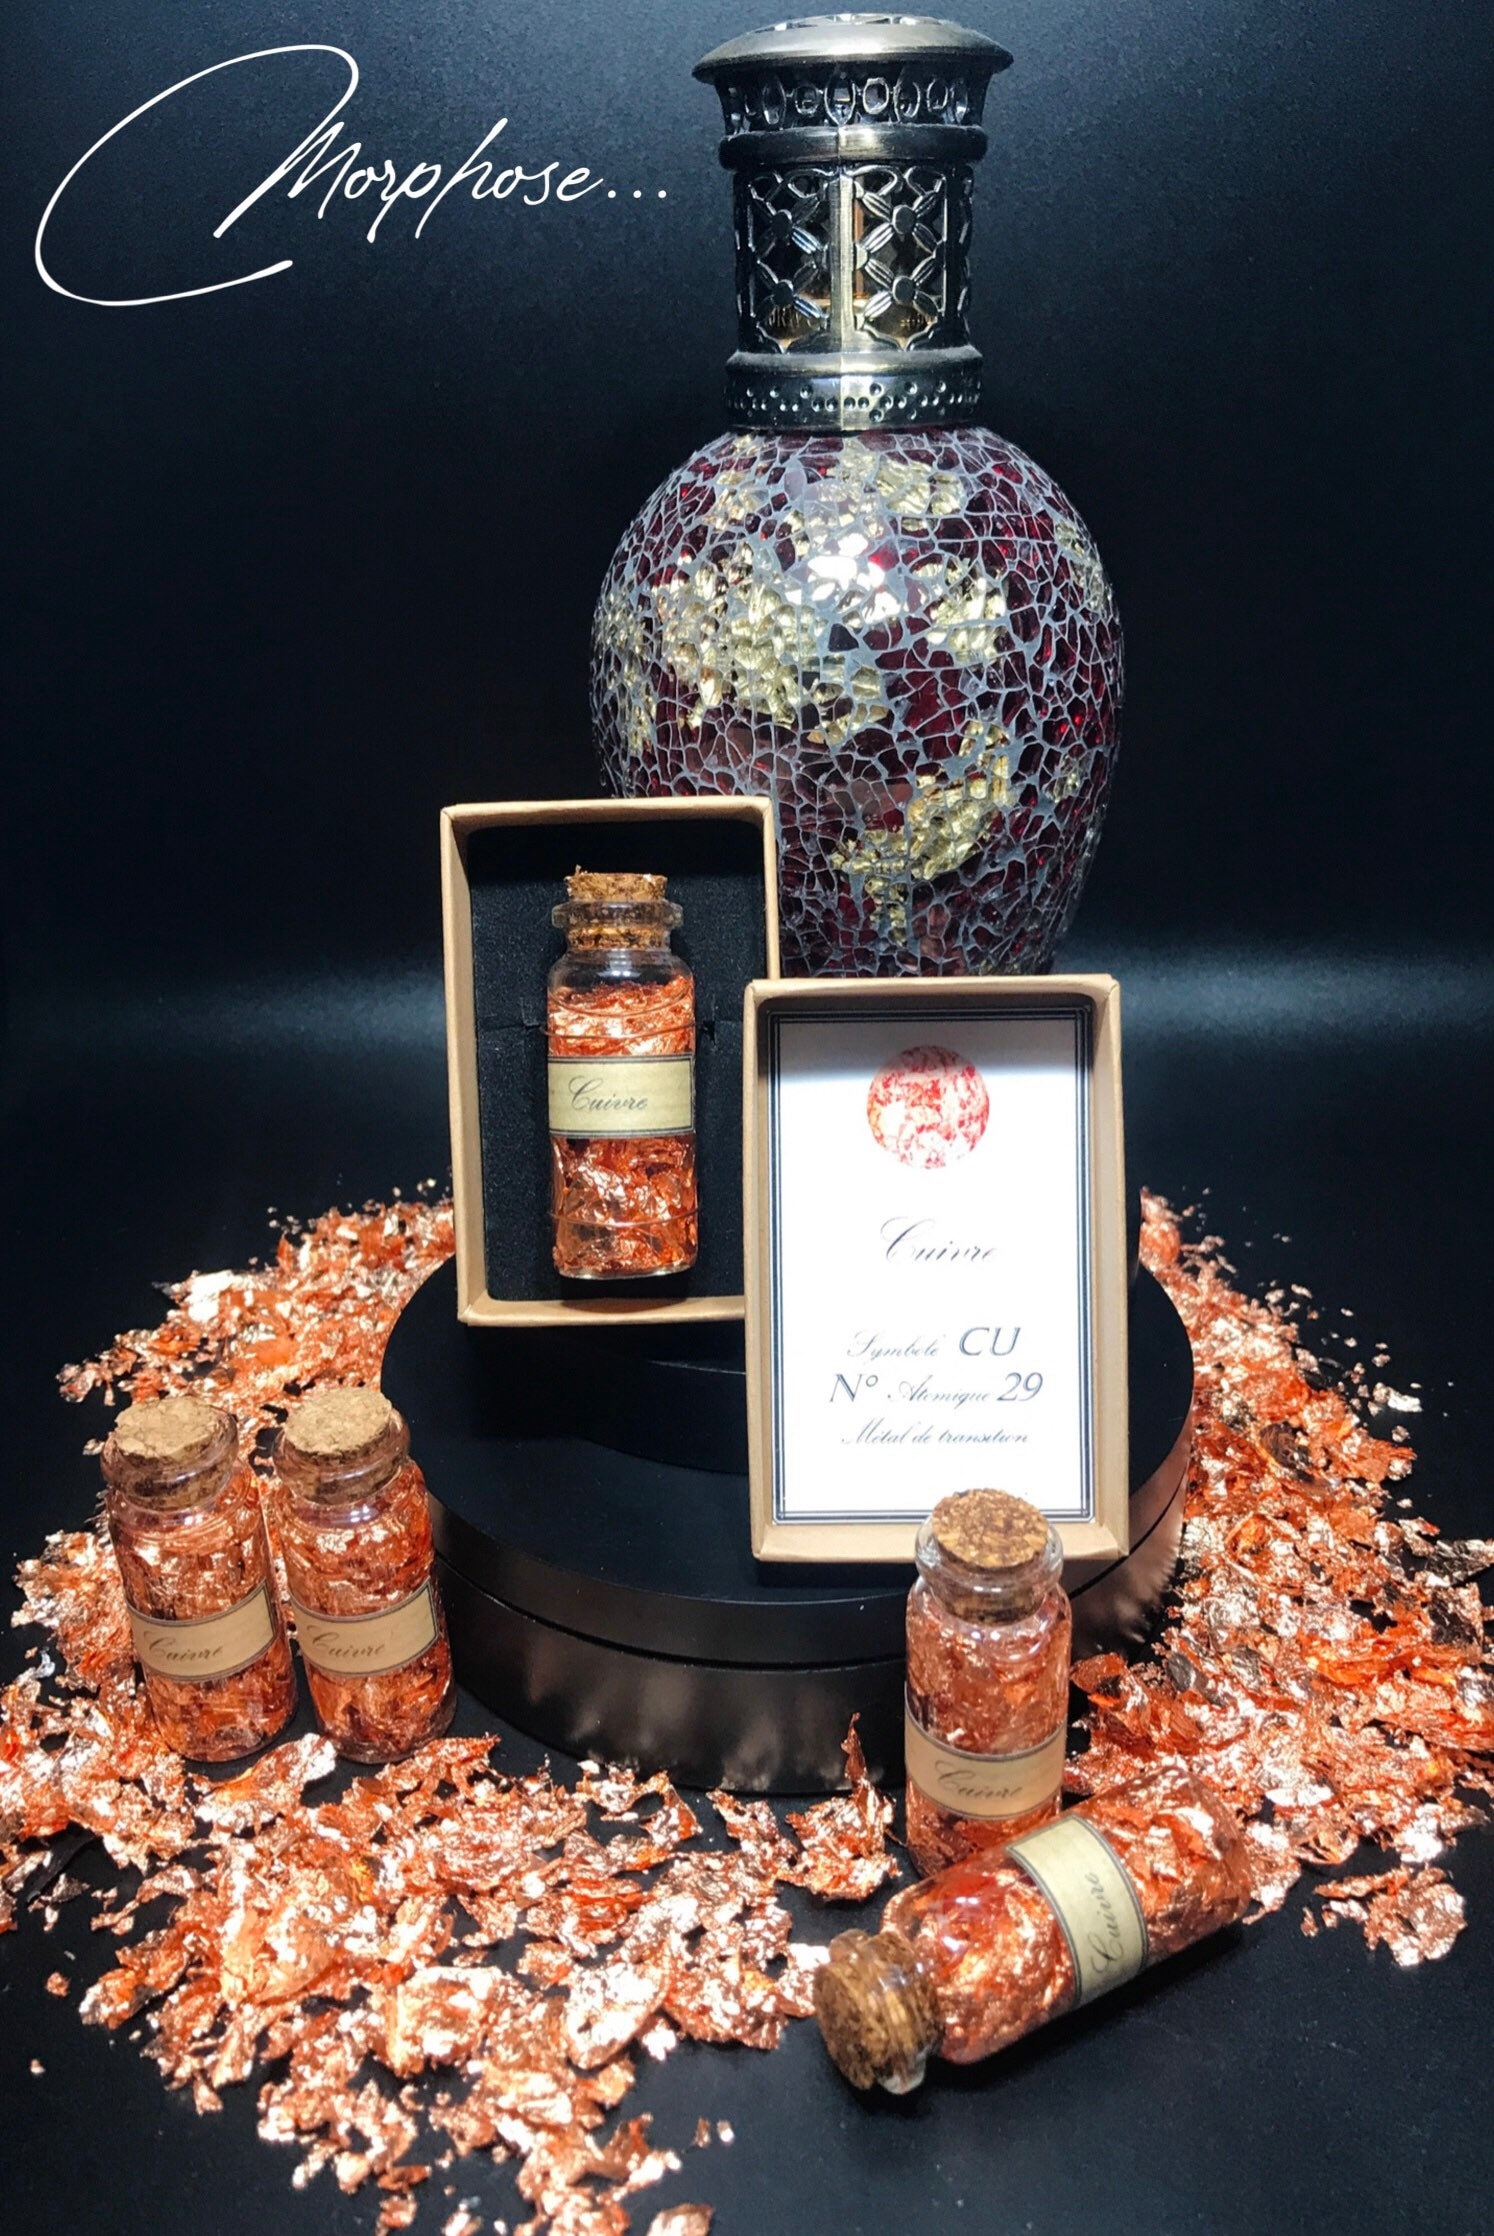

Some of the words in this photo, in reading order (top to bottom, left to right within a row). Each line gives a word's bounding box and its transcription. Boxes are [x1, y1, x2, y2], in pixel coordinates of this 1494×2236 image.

[568, 1075, 648, 1112] Cuivre
[880, 1216, 997, 1263] Cuivre
[959, 1326, 1021, 1356] CU
[996, 1371, 1043, 1402] 29
[911, 1423, 935, 1444] de
[937, 1428, 1028, 1444] transition
[143, 1629, 223, 1662] Cuivre
[307, 1624, 385, 1658] Cuivre
[935, 1760, 1023, 1798] Cuivre
[1089, 1871, 1125, 1975] Cuivre
